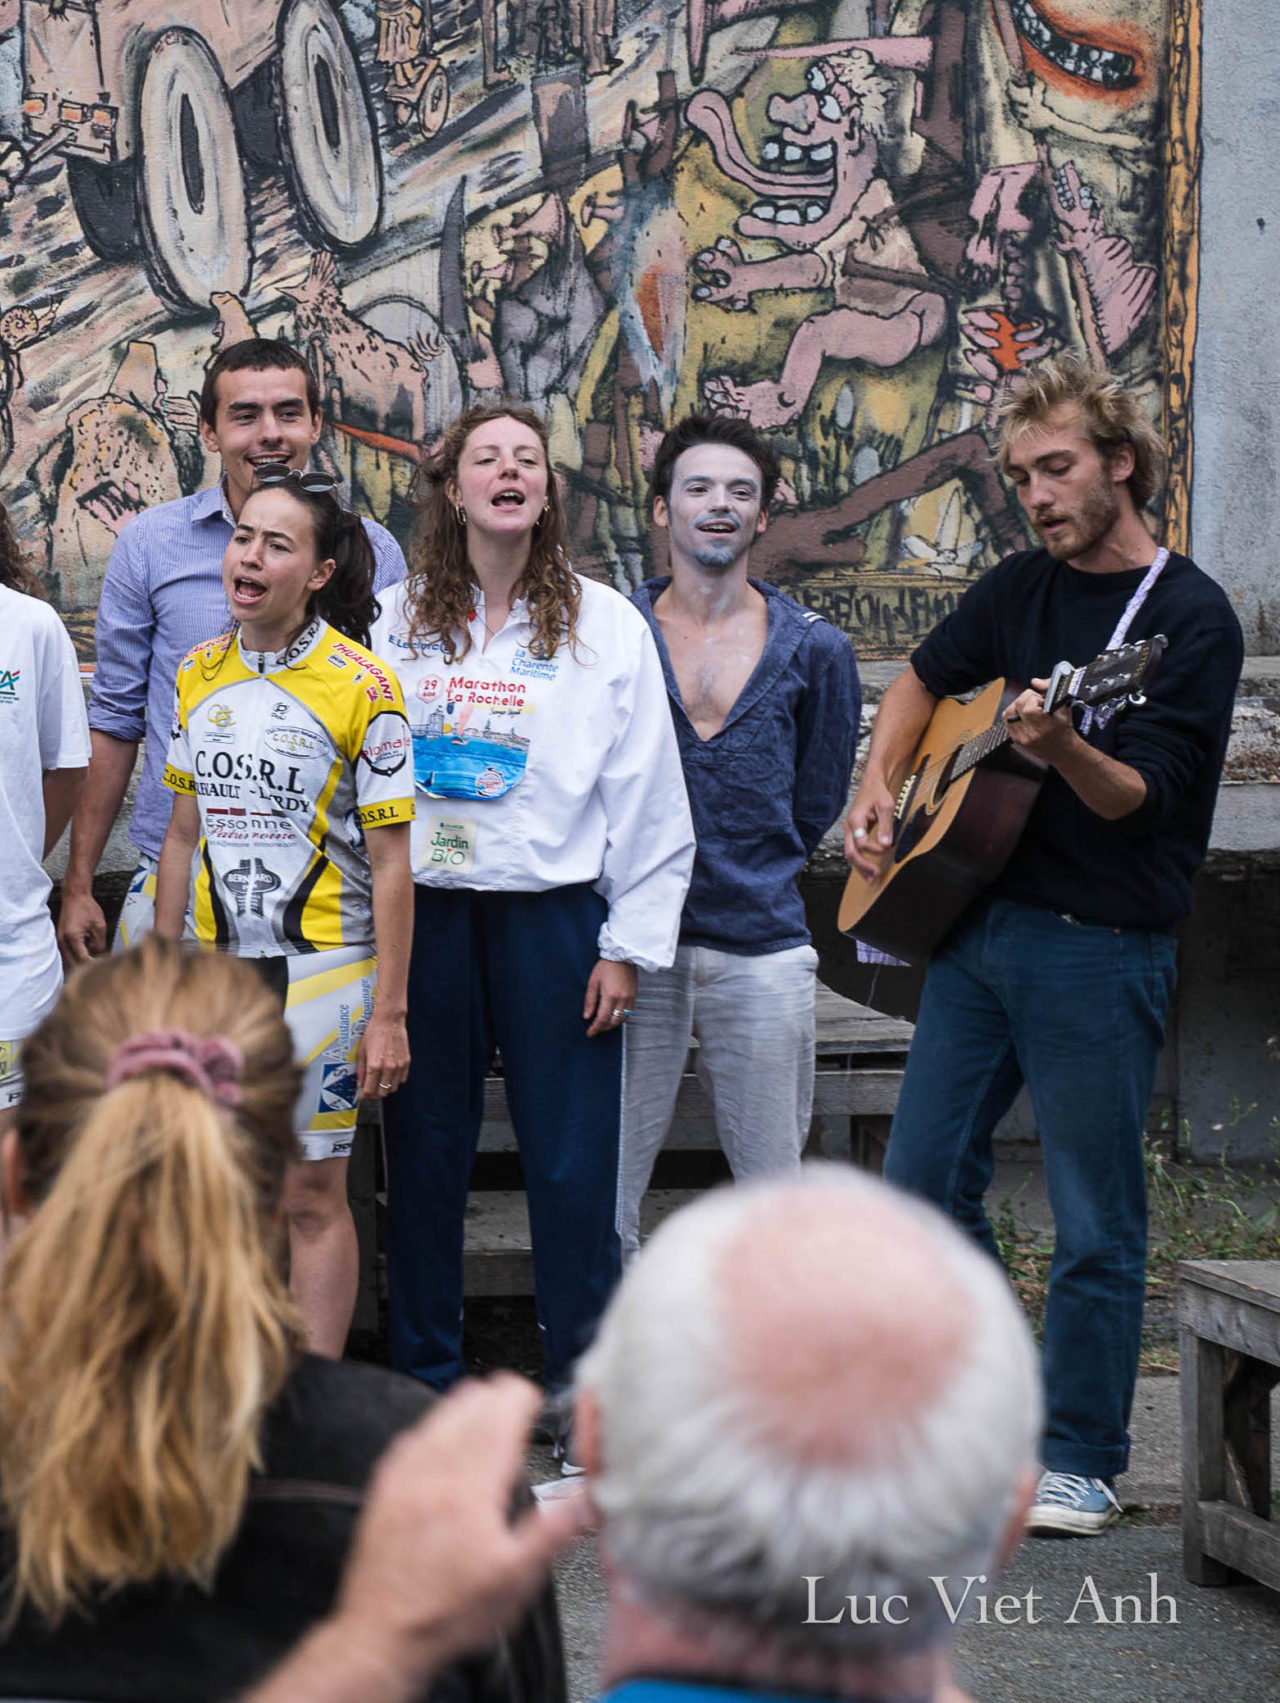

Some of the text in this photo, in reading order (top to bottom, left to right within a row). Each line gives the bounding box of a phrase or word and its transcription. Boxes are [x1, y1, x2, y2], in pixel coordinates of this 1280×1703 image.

[423, 679, 438, 690] 29
[448, 676, 526, 694] Marathon
[467, 691, 525, 708] Rochelle
[430, 831, 469, 850] Jardin
